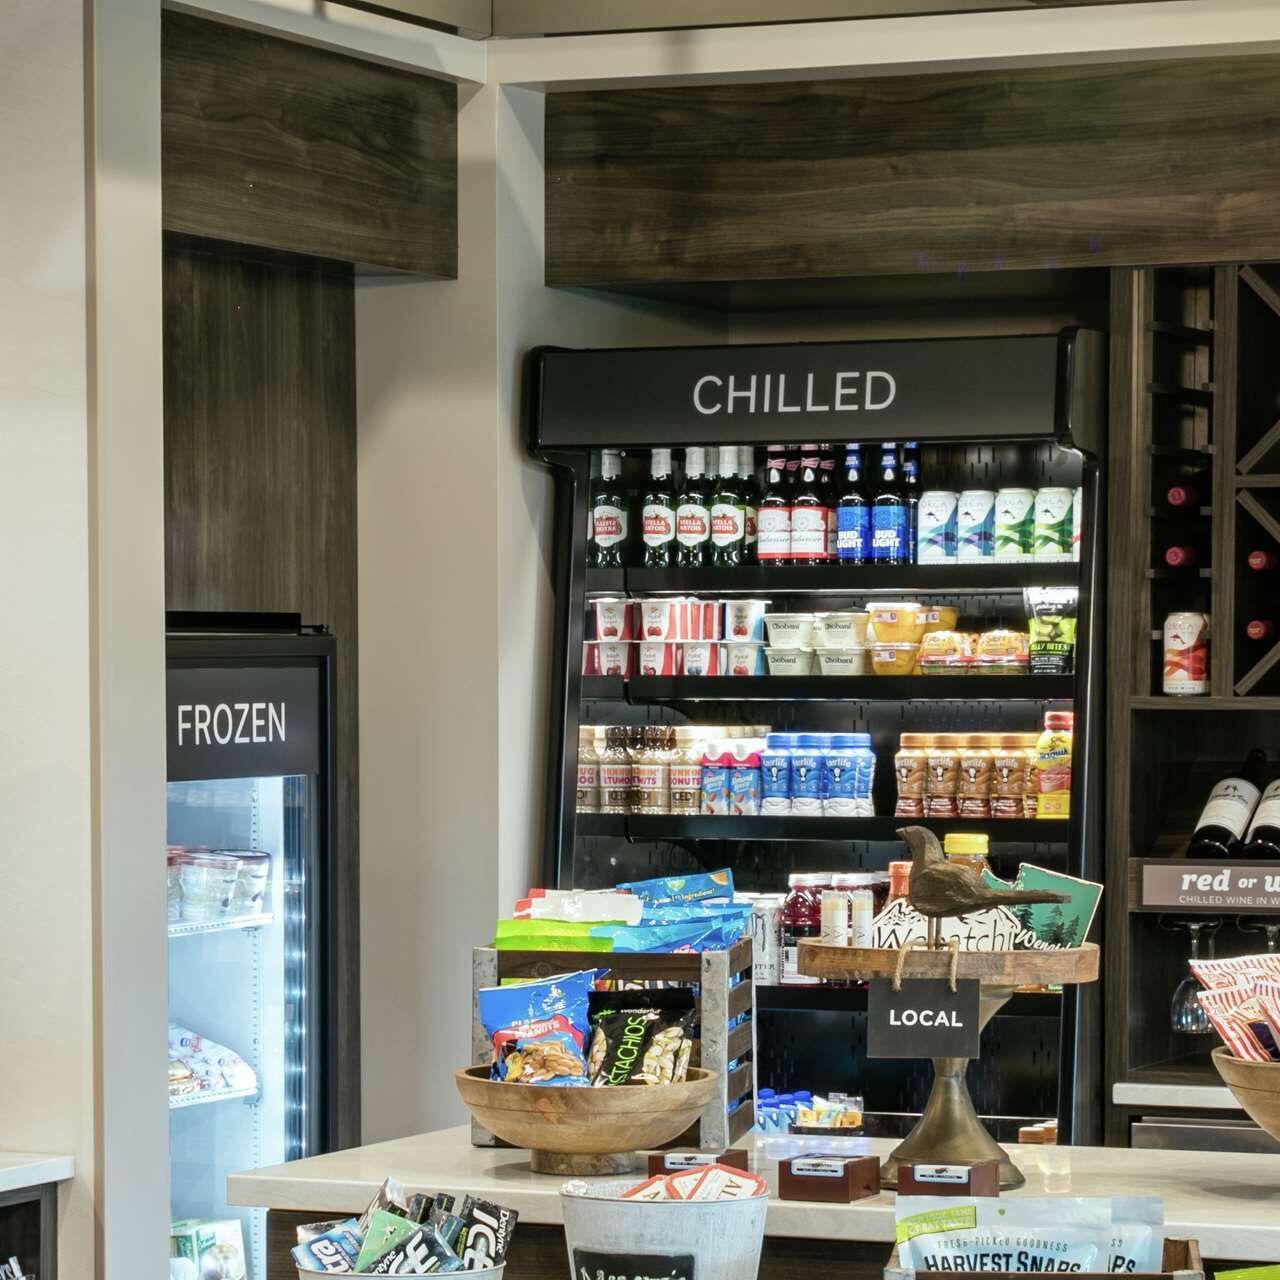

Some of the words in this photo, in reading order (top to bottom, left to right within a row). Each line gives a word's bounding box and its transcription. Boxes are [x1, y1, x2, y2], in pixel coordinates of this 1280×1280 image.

[693, 369, 897, 416] CHILLED
[839, 531, 858, 539] BUD
[873, 538, 900, 547] LIGHT
[875, 530, 896, 538] BUD
[772, 623, 799, 631] Chobani
[177, 701, 287, 746] FROZEN
[1181, 869, 1232, 892] red
[1238, 876, 1257, 889] or
[1178, 895, 1223, 905] CHILLED
[1225, 895, 1254, 906] WINE
[1256, 896, 1267, 906] IN
[890, 1009, 963, 1028] LOCAL
[497, 1210, 509, 1253] Dentyne
[1016, 1238, 1068, 1253] GOODNESS
[924, 1252, 1016, 1272] HARVEST
[1017, 1250, 1081, 1273] SNAPS
